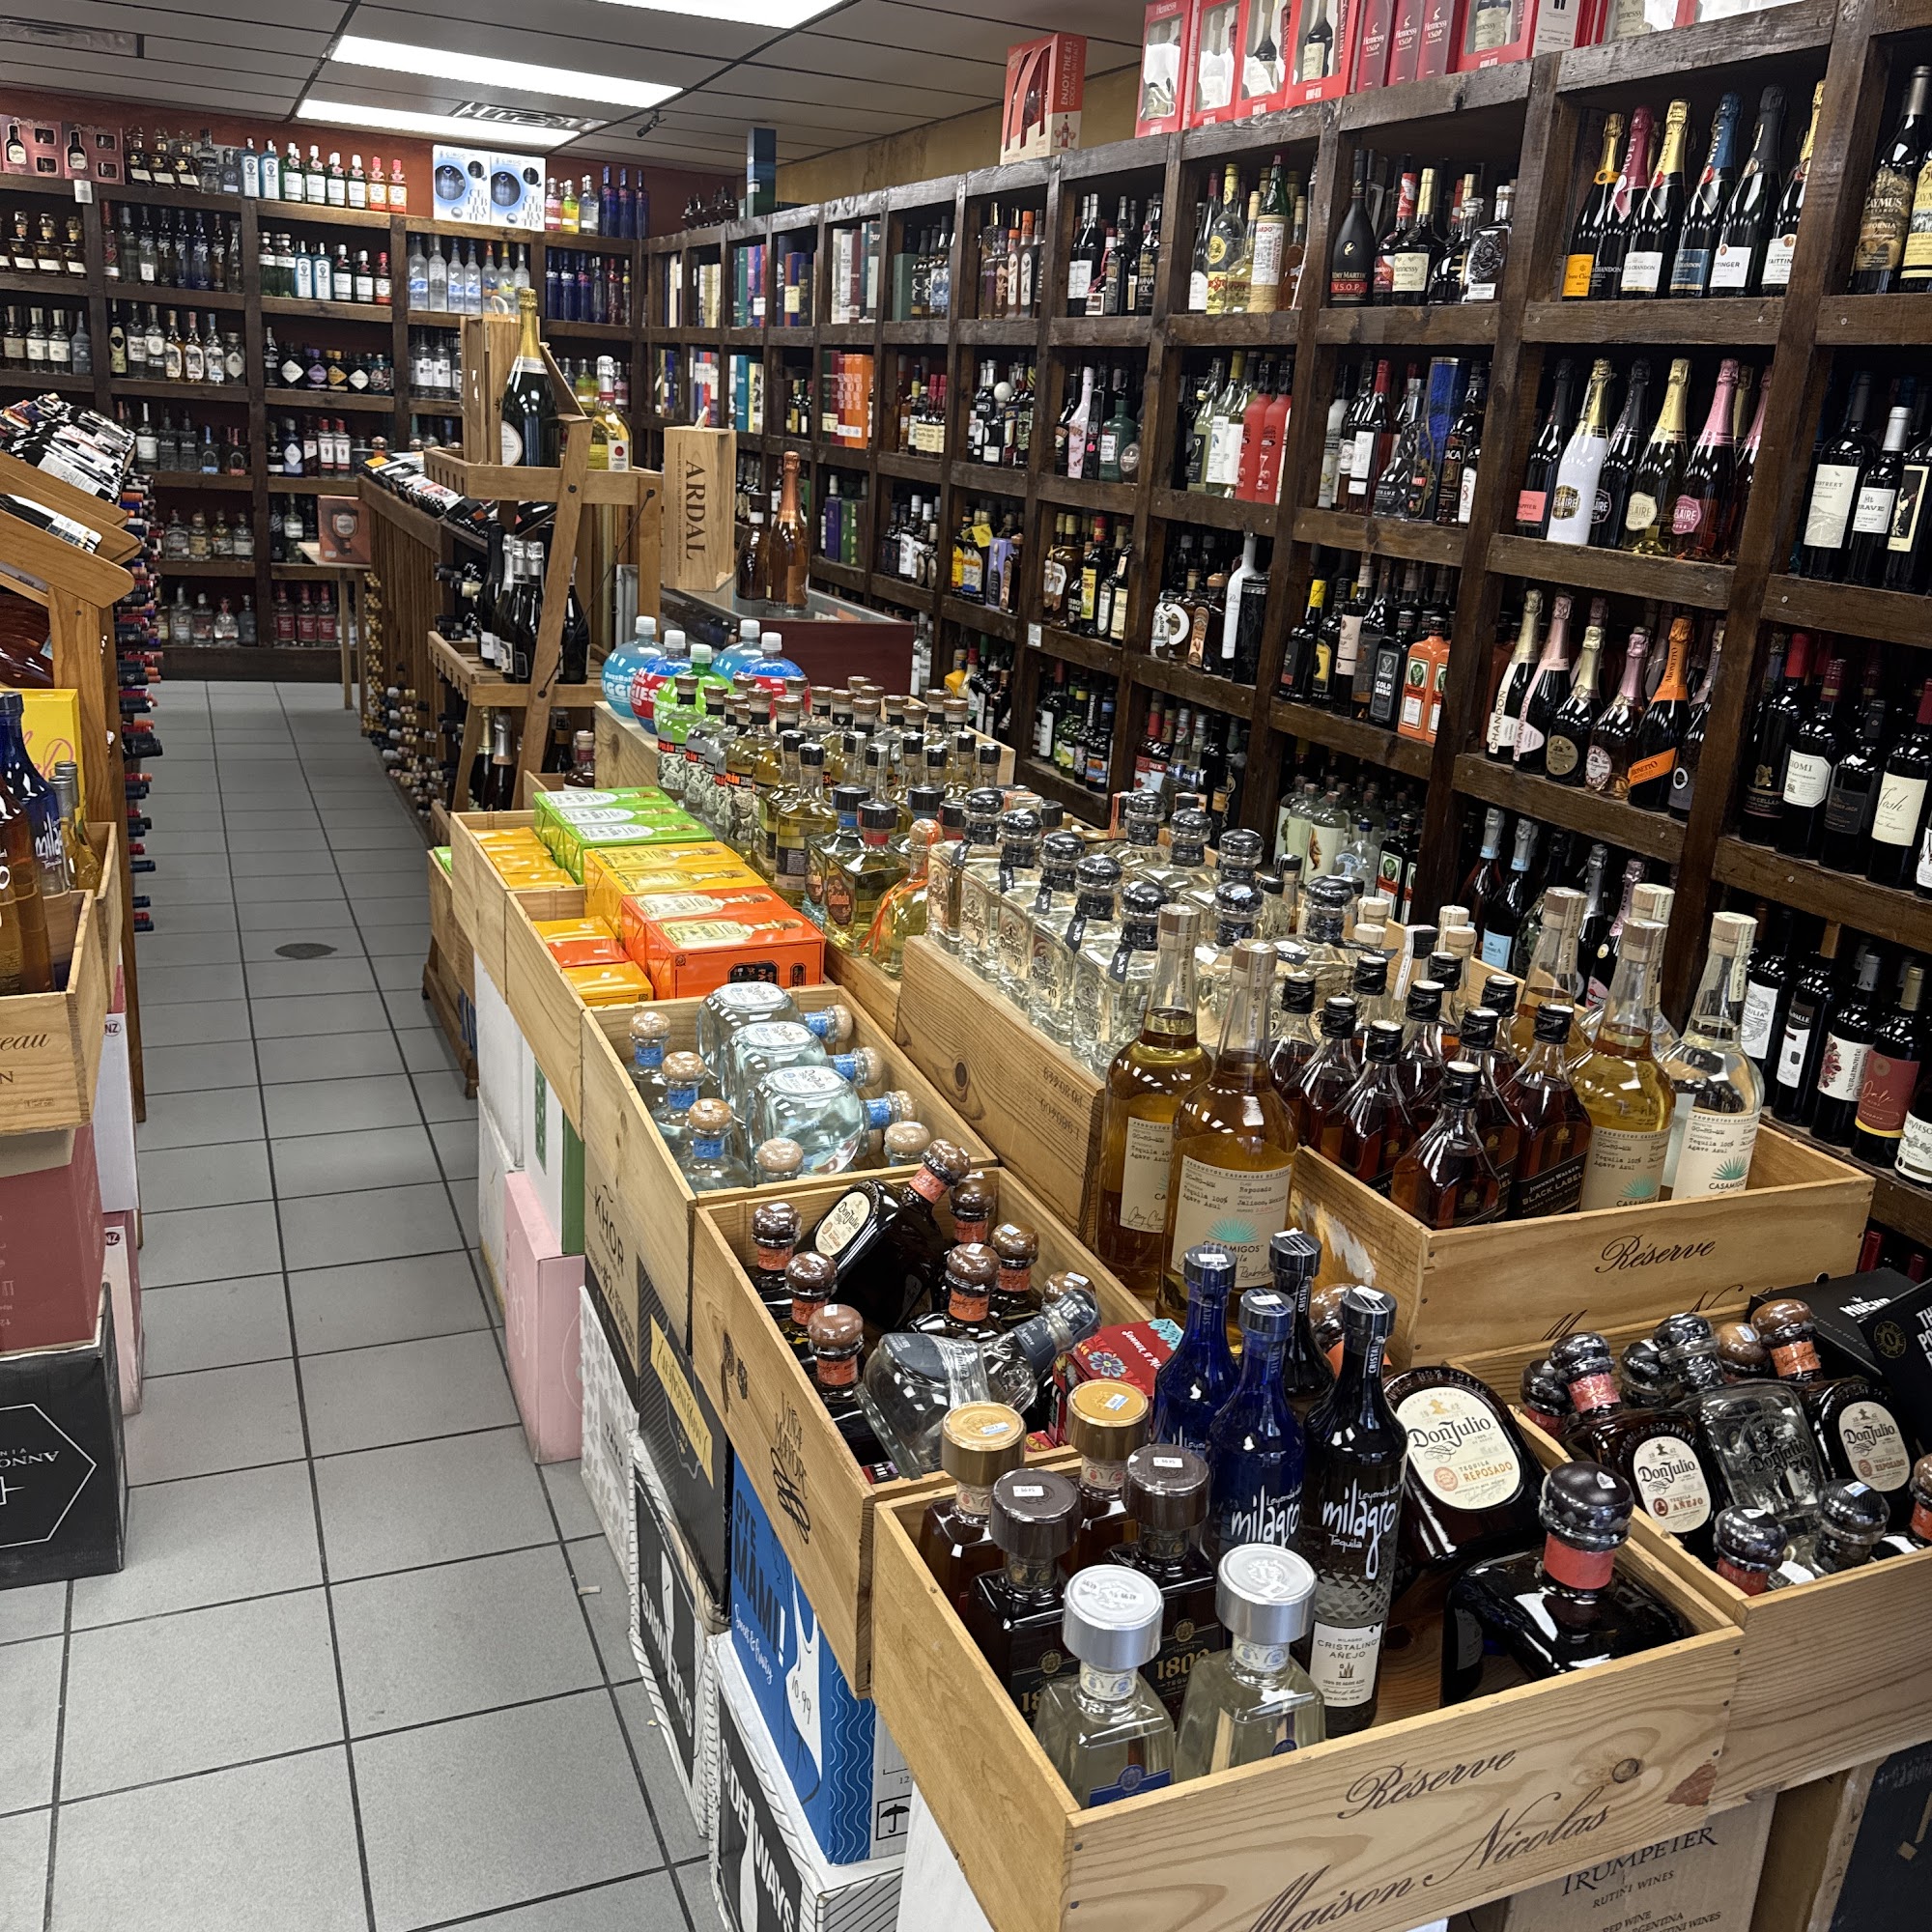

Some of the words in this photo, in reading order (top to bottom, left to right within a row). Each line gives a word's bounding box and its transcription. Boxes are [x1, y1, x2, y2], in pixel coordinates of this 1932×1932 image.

[1396, 27, 1417, 40] Hennessy
[1424, 19, 1448, 33] Hennessy
[1363, 34, 1385, 44] Hennessy
[1061, 73, 1072, 105] ENJOY
[1865, 197, 1903, 209] CAYMUS
[1914, 192, 1932, 203] CAYM
[686, 460, 706, 561] ARDAL
[605, 671, 632, 682] BuzzBall
[1375, 688, 1391, 696] BREW
[1377, 681, 1391, 690] COLD
[1490, 690, 1507, 752] CHANDON
[1514, 696, 1530, 757] CHANDON
[35, 811, 62, 859] mila
[1133, 1122, 1170, 1131] PRODUCTOS
[1693, 1115, 1731, 1123] PRODUCTOS
[1600, 1129, 1639, 1139] PRODUCTOS
[1688, 1145, 1709, 1153] Agave
[1690, 1137, 1717, 1148] Tequila
[1130, 1152, 1151, 1162] Agave
[1131, 1146, 1157, 1156] Tequila
[1595, 1153, 1625, 1164] Tequila
[1186, 1160, 1222, 1176] PRODUCTOS
[1225, 1171, 1264, 1180] CASAMIGOS
[1594, 1160, 1615, 1169] Agave
[1528, 1177, 1554, 1194] JOHNNIE
[1554, 1165, 1581, 1180] WALKER
[1709, 1179, 1746, 1190] CASAMIGO
[1183, 1185, 1208, 1201] Tequila
[1211, 1196, 1228, 1206] 100%
[1239, 1185, 1272, 1194] Reposado
[1521, 1187, 1553, 1207] BLACK
[1555, 1173, 1584, 1190] LABEL
[1182, 1193, 1202, 1206] Agave
[1204, 1202, 1222, 1211] Azul
[1236, 1199, 1268, 1208] Jalisco,
[1595, 1235, 1716, 1273] Réserve
[1916, 1306, 1932, 1326] TH
[1459, 1461, 1490, 1472] TEQUILA
[1463, 1462, 1514, 1483] REPOSADO
[1357, 1485, 1389, 1500] Leyenda
[1673, 1496, 1703, 1512] AÑEJO
[734, 1490, 757, 1552] OYE
[1321, 1477, 1398, 1580] milagro
[1328, 1533, 1363, 1553] Tequila
[732, 1537, 787, 1668] MAMI!
[1317, 1638, 1377, 1652] CRISTALINO
[1329, 1649, 1366, 1661] AÑEJO
[1156, 1648, 1211, 1682] 180
[1338, 1749, 1518, 1820] Réserve
[720, 1737, 794, 1925] SIDEWAYS
[1423, 1784, 1610, 1888] Nicolas
[1592, 1885, 1634, 1909] RUTINI
[1637, 1868, 1676, 1892] WINES
[1624, 1910, 1653, 1927] WINE
